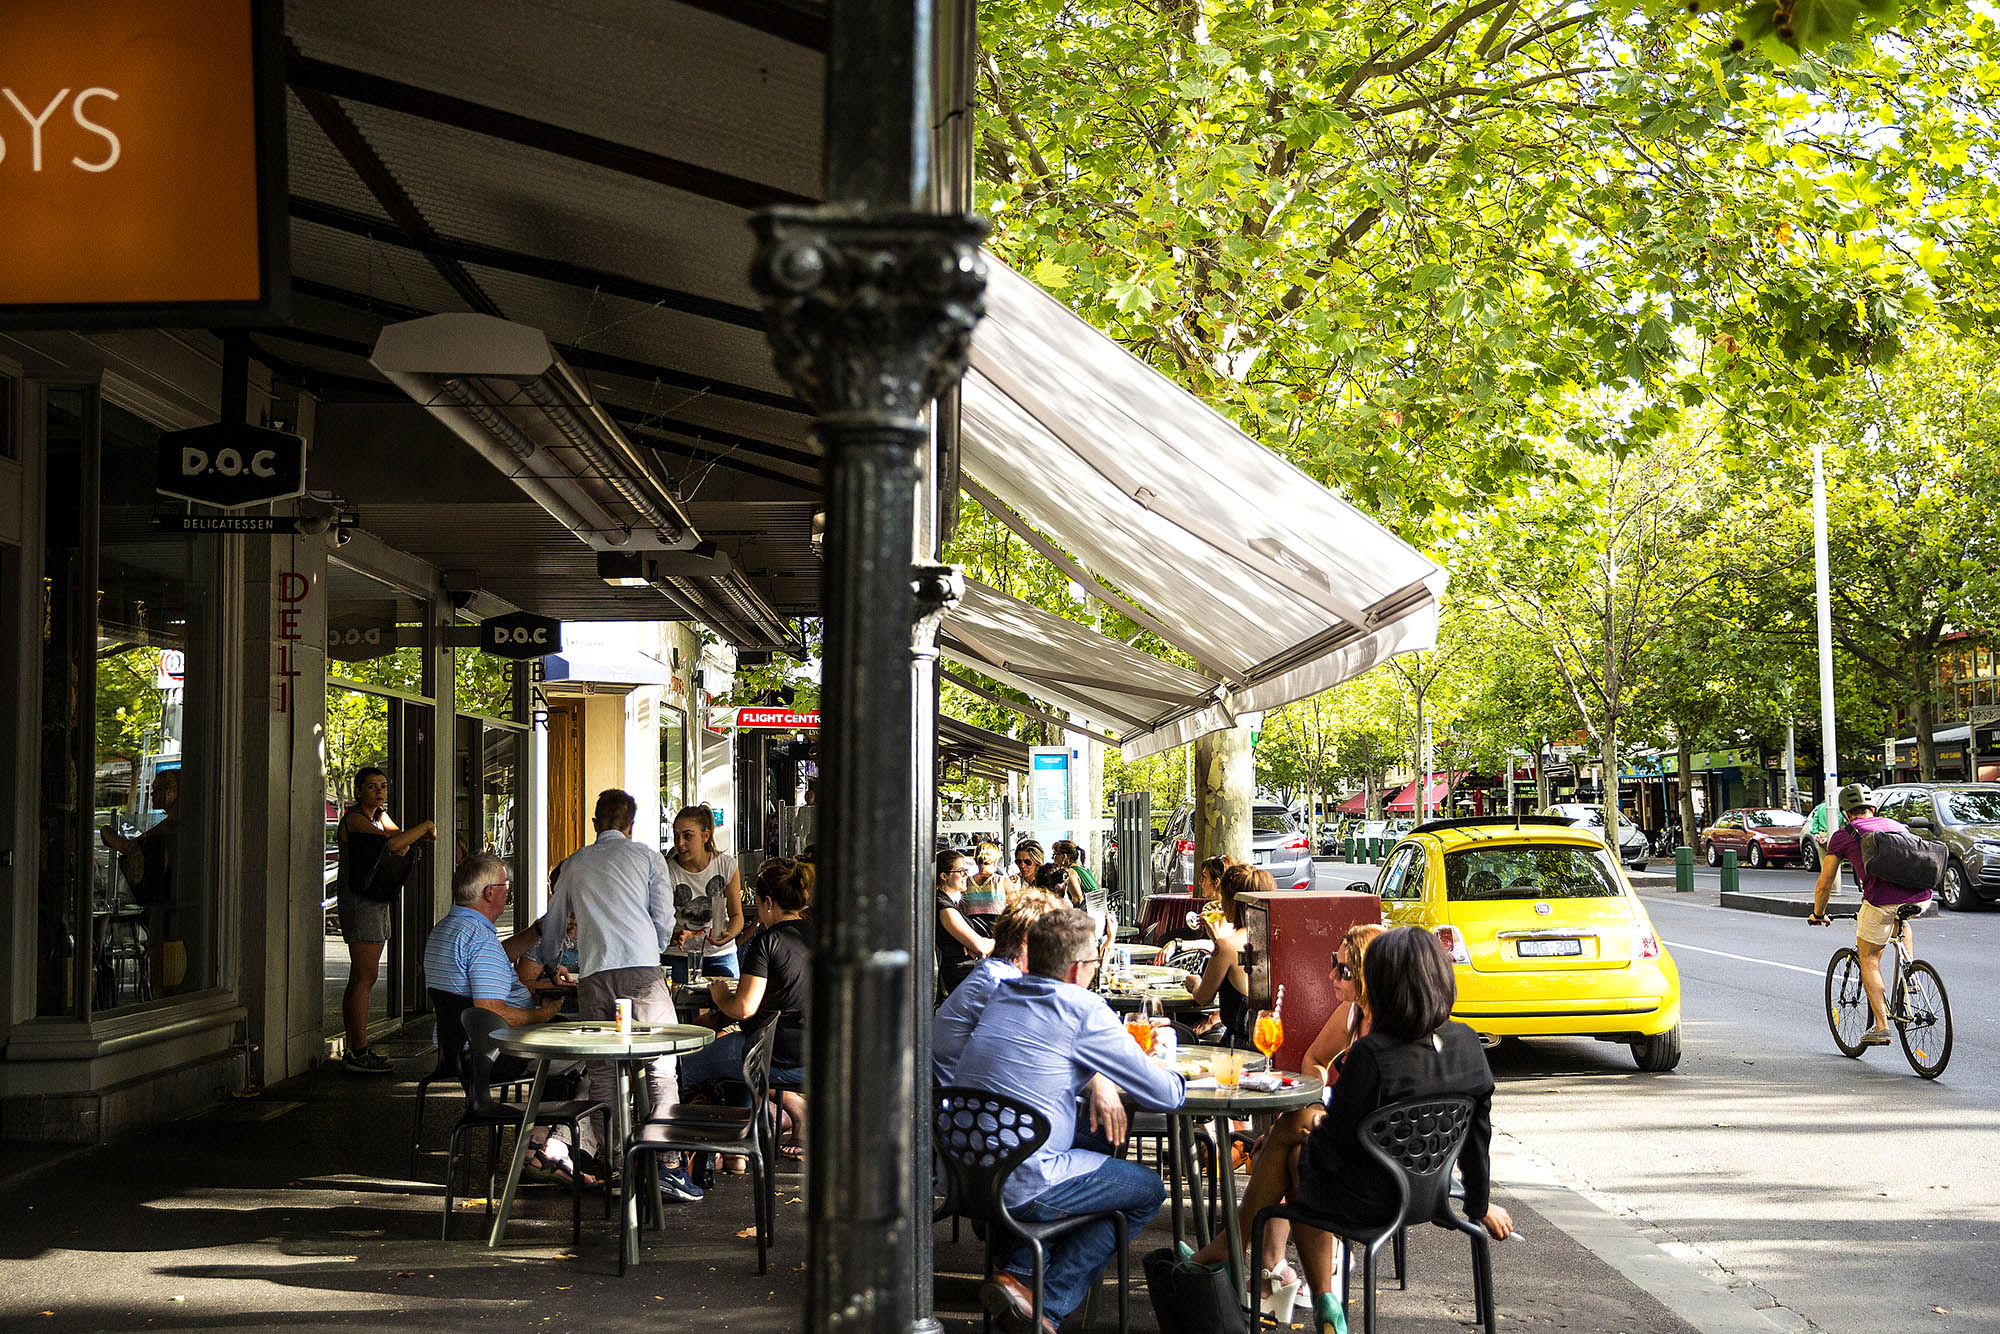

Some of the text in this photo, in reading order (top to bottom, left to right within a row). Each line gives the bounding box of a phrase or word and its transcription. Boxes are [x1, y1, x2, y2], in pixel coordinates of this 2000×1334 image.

[0, 87, 121, 173] YS
[181, 446, 277, 478] D.O.C
[182, 517, 274, 530] DELICATESSEN
[280, 571, 310, 714] DELI
[493, 626, 548, 645] D.O.C
[531, 661, 551, 732] BAR
[742, 713, 784, 723] FLIGHT
